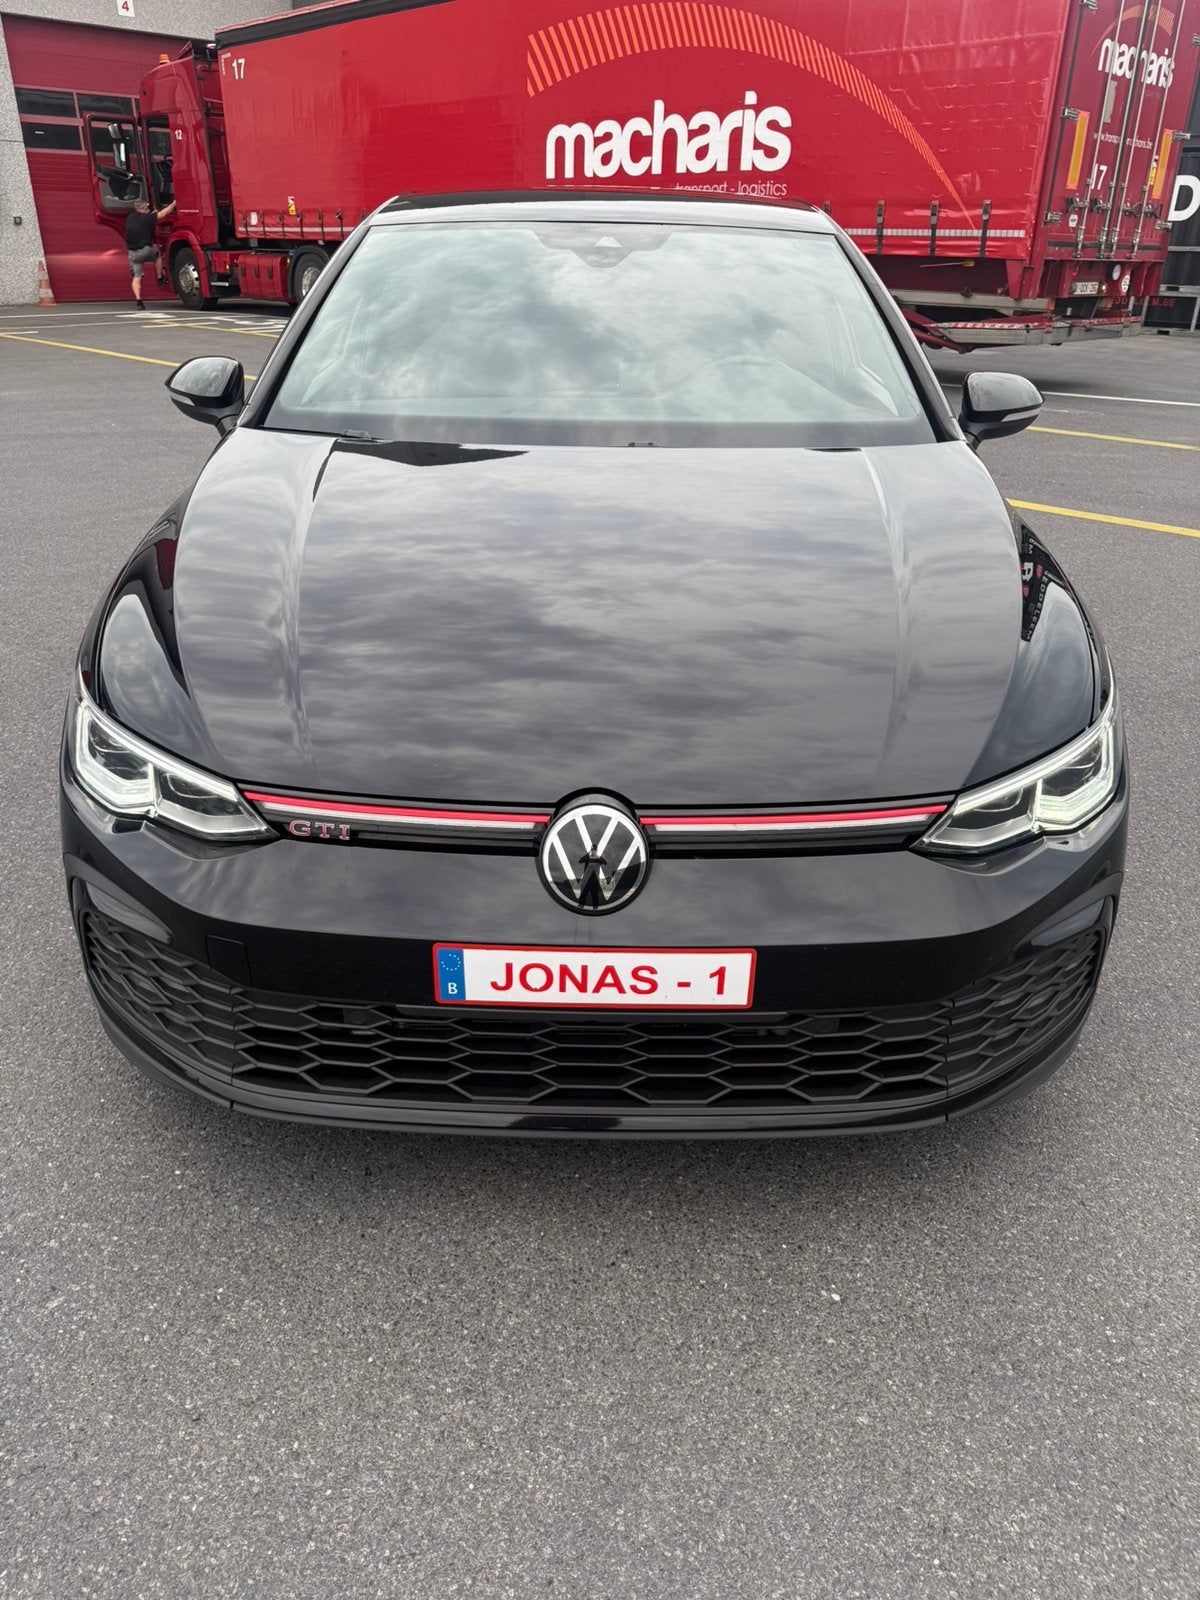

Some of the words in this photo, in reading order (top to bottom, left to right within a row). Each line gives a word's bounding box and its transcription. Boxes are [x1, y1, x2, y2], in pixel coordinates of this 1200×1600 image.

[122, 1, 129, 11] 4
[232, 58, 245, 79] 17
[175, 129, 183, 140] 12
[545, 90, 792, 179] macharis
[1092, 163, 1108, 190] 17
[737, 180, 787, 196] logistics
[1168, 175, 1200, 222] D
[289, 819, 351, 841] GTI
[448, 983, 457, 994] B
[490, 963, 658, 995] JONAS
[709, 966, 726, 995] 1
